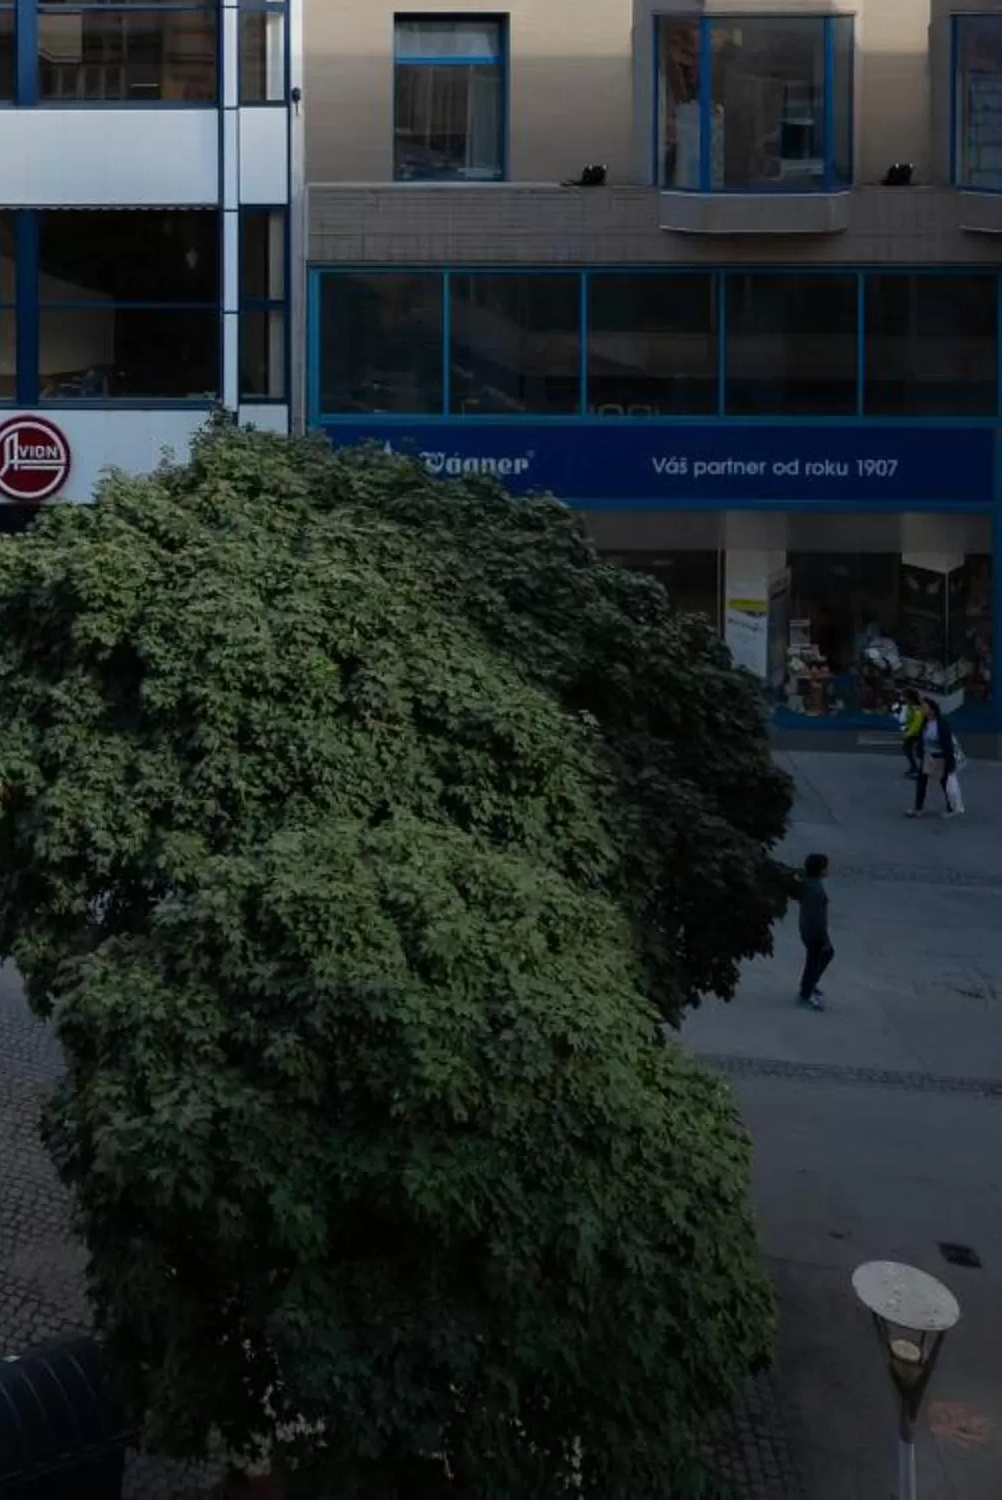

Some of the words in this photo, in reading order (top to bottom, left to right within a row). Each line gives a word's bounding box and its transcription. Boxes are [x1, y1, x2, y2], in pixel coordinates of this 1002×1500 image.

[651, 455, 689, 476] Váš
[693, 457, 768, 480] partner
[771, 457, 800, 477] od
[804, 458, 850, 477] roku
[855, 458, 899, 477] 1907
